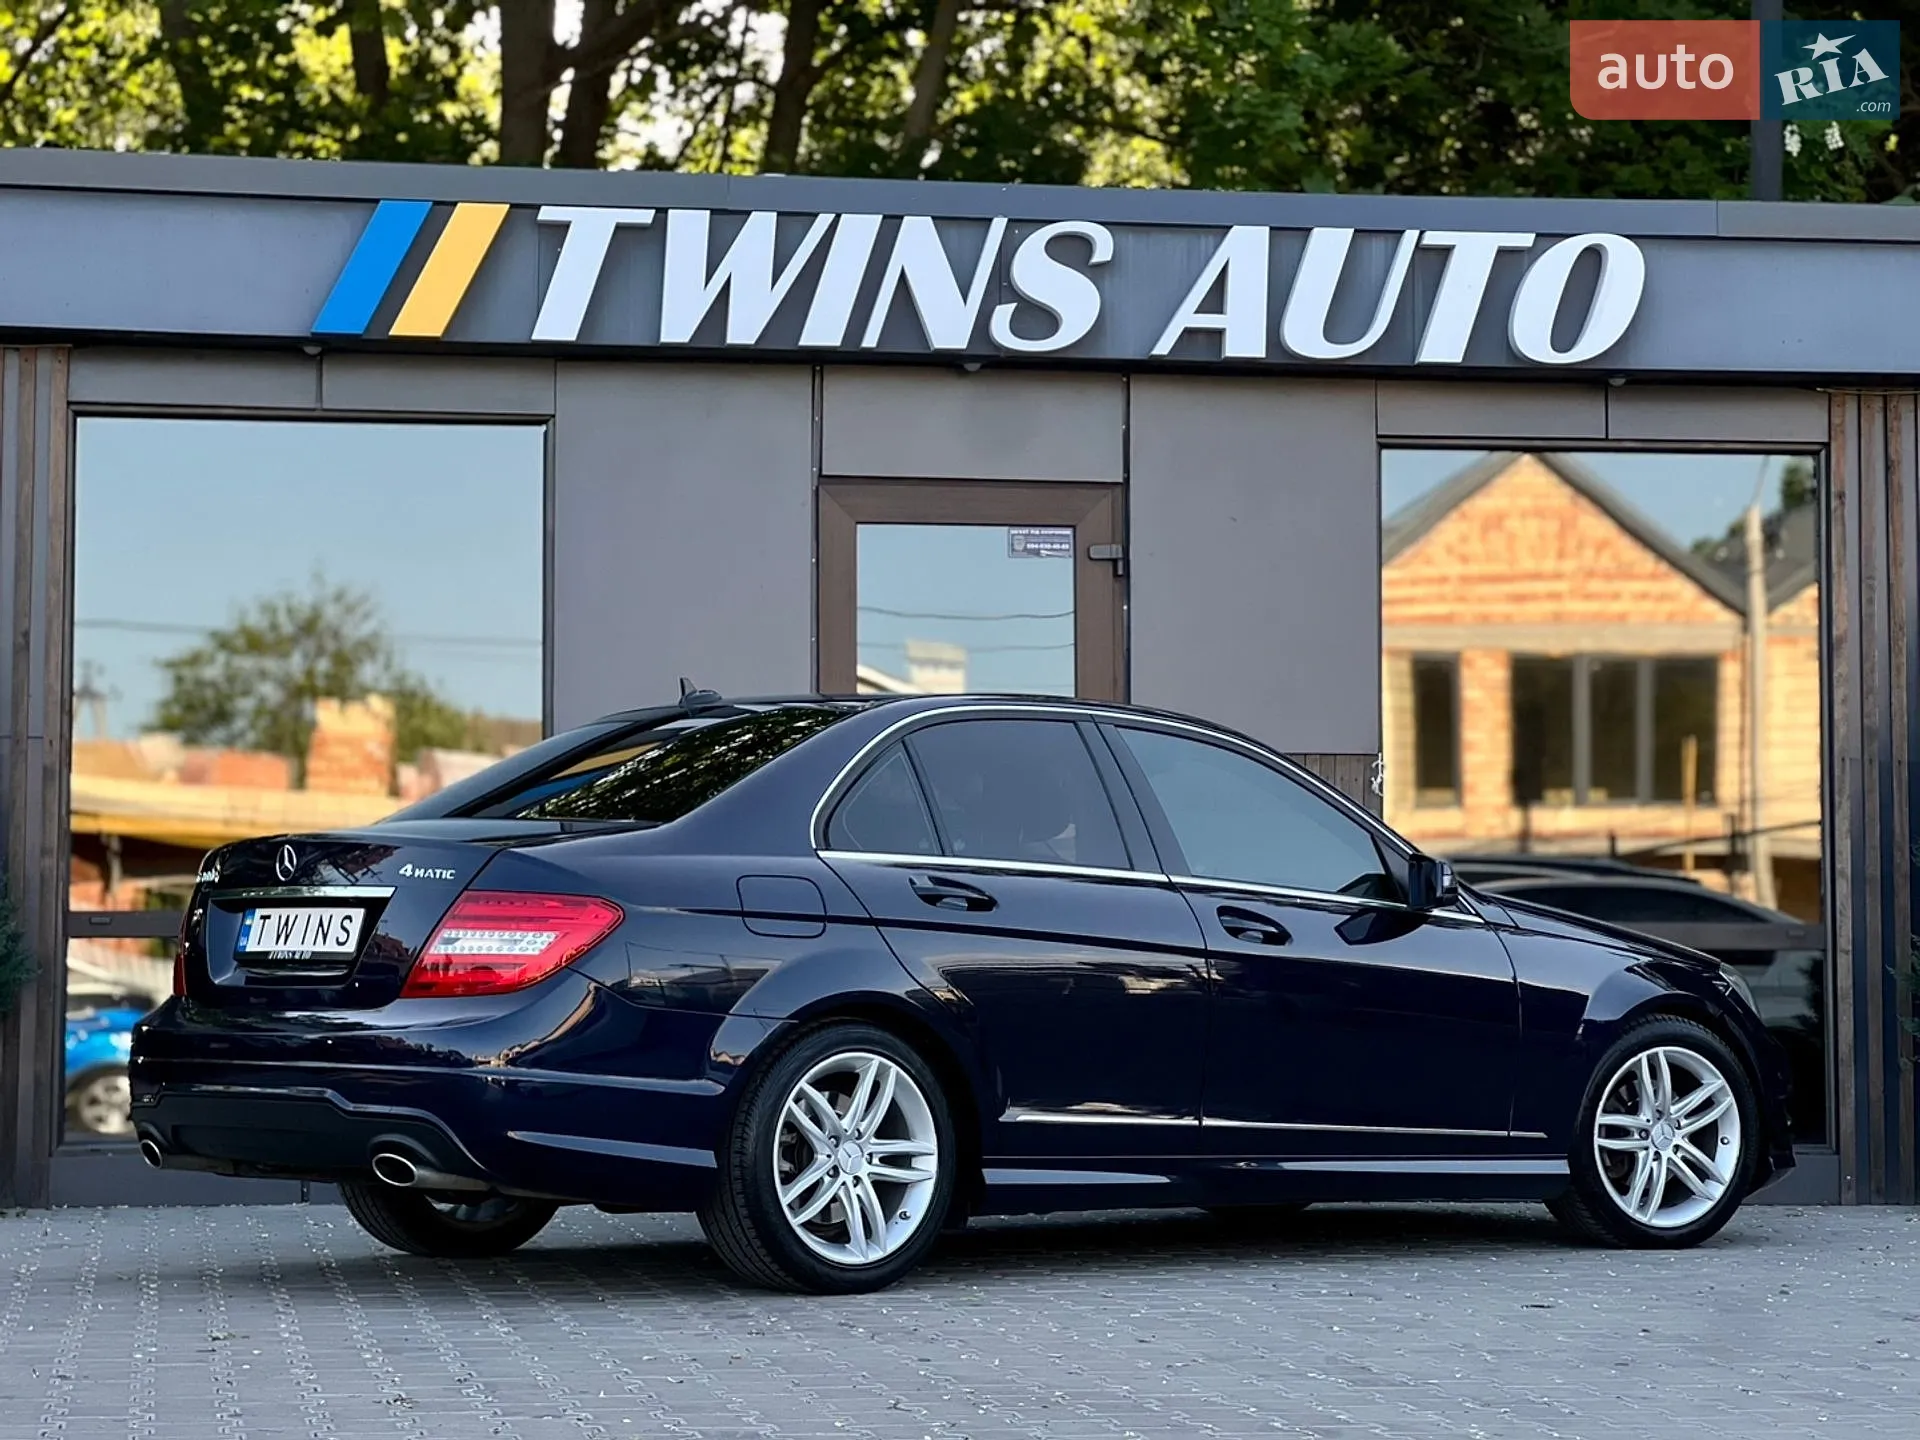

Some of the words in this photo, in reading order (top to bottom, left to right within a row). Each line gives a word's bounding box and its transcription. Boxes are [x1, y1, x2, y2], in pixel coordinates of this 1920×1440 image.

[530, 205, 1114, 353] TWINS
[1149, 225, 1646, 365] AUTO
[399, 863, 456, 879] 4MATIC
[256, 914, 353, 946] TWINS
